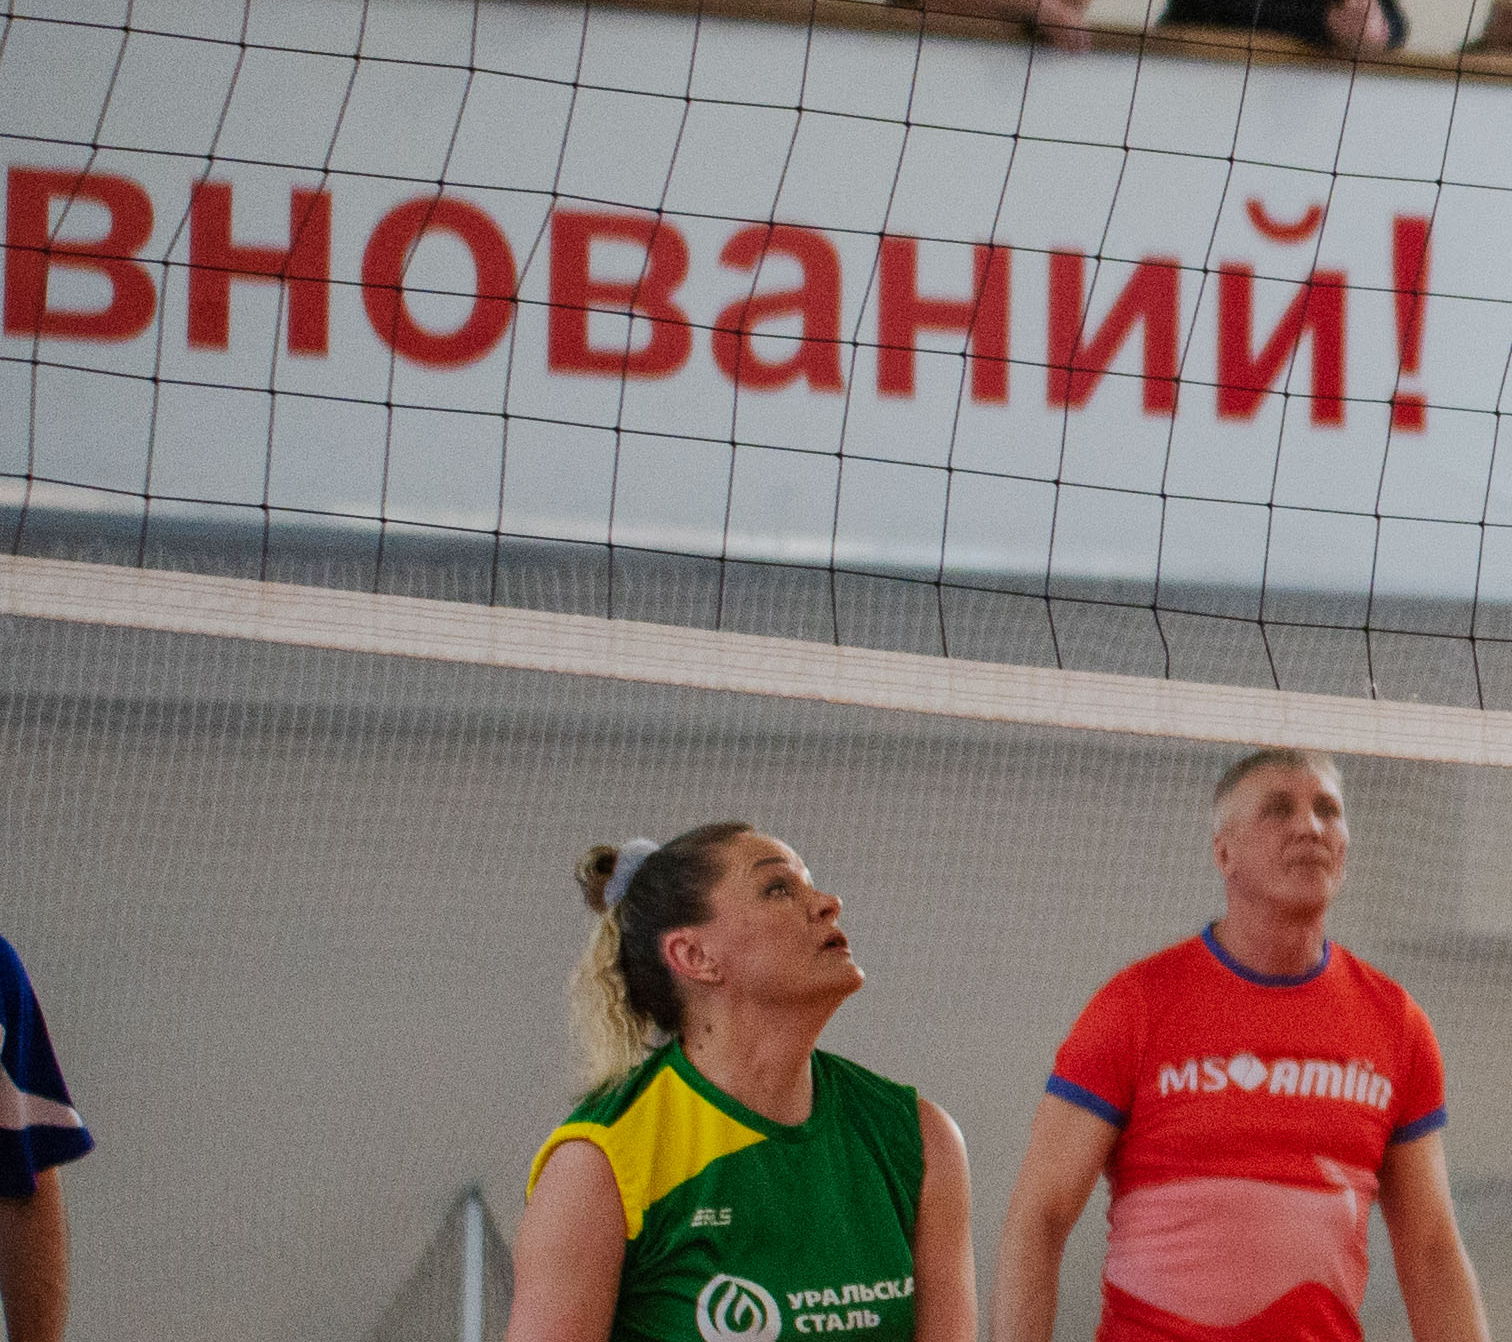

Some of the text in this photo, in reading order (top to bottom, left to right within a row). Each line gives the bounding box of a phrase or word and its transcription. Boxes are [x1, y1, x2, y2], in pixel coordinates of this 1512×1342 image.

[3, 164, 1433, 433] внований!
[1159, 1057, 1229, 1097] MS
[794, 1309, 881, 1334] СТАЛЬ
